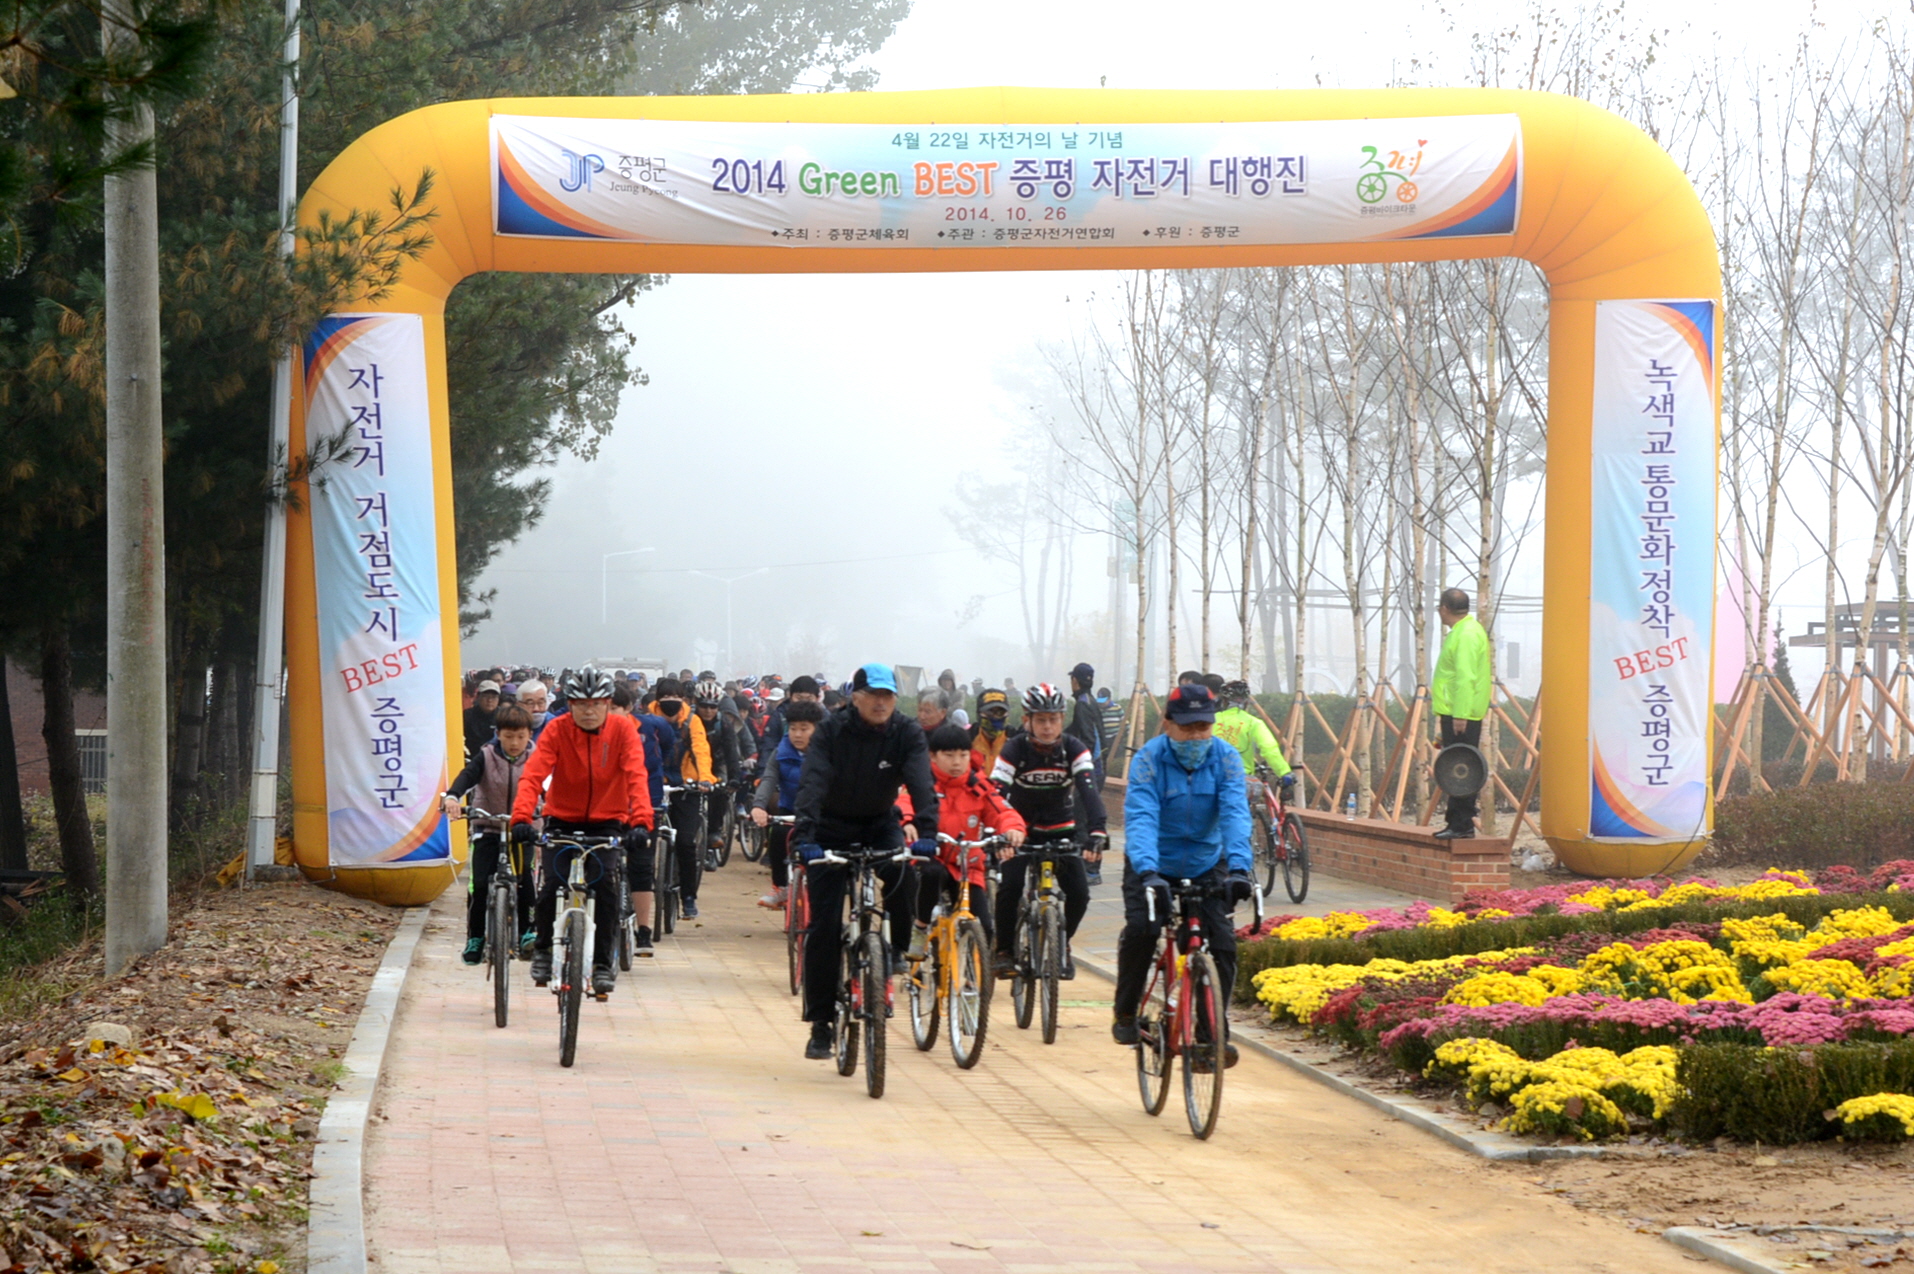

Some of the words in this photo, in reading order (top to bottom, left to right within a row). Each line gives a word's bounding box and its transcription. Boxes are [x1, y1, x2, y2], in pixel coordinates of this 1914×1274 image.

[891, 131, 920, 150] 4월
[929, 131, 969, 150] 22일
[978, 131, 1051, 150] 자전거의
[1061, 131, 1079, 150] 날
[1088, 131, 1123, 150] 기념
[618, 155, 667, 183] 증평군
[711, 157, 786, 195] 2014
[798, 161, 899, 196] Green
[912, 161, 998, 196] BEST
[1009, 158, 1073, 199] 증평
[1092, 157, 1189, 197] 자전거
[1209, 155, 1305, 196] 대행진
[781, 227, 809, 241] 주최
[827, 227, 909, 241] 증평군체육회
[945, 206, 995, 222] 2014.
[1006, 206, 1032, 222] 10.
[1044, 206, 1067, 221] 26
[947, 228, 975, 241] 주관
[992, 227, 1115, 241] 증평군자전거연합회
[1154, 226, 1181, 239] 후원
[1199, 225, 1241, 239] 증평군
[347, 363, 385, 477] 자전거
[354, 491, 399, 643] 거점도시
[339, 643, 420, 694] BEST
[1613, 636, 1691, 681] BEST
[369, 696, 409, 809] 증평군
[1640, 684, 1674, 786] 증평군
